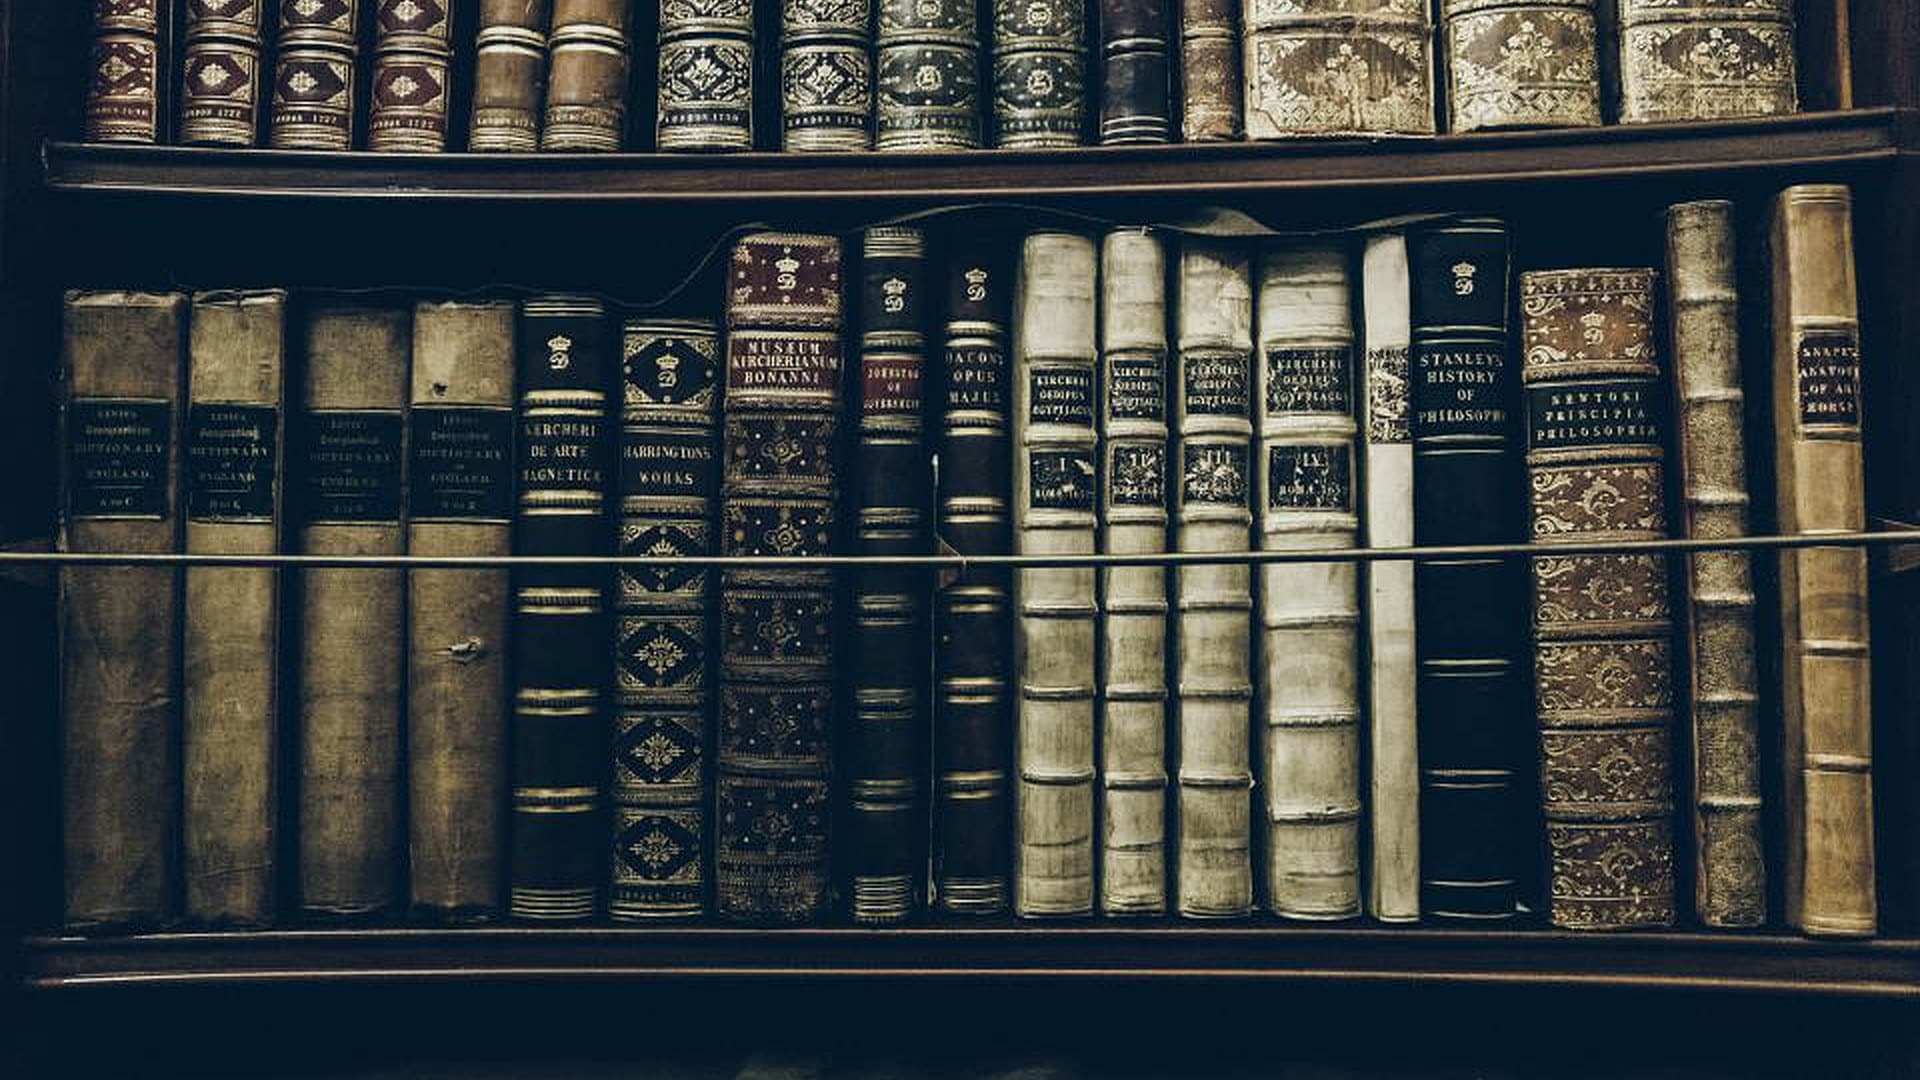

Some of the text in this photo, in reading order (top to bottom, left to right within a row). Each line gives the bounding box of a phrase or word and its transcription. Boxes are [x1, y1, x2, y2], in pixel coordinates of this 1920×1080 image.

[732, 354, 839, 369] KIRCHERIANUM
[1276, 359, 1343, 369] KIRCHERI
[744, 370, 820, 385] BONANNI
[952, 369, 996, 384] OPUS
[1426, 370, 1496, 384] HISTORY
[1457, 388, 1475, 402] OF
[1808, 383, 1828, 396] OF
[949, 390, 1001, 404] MAJUS
[1544, 407, 1646, 422] PRINCIPIA
[1806, 401, 1855, 414] HORSE
[531, 444, 547, 458] DE
[639, 470, 695, 486] WORKS
